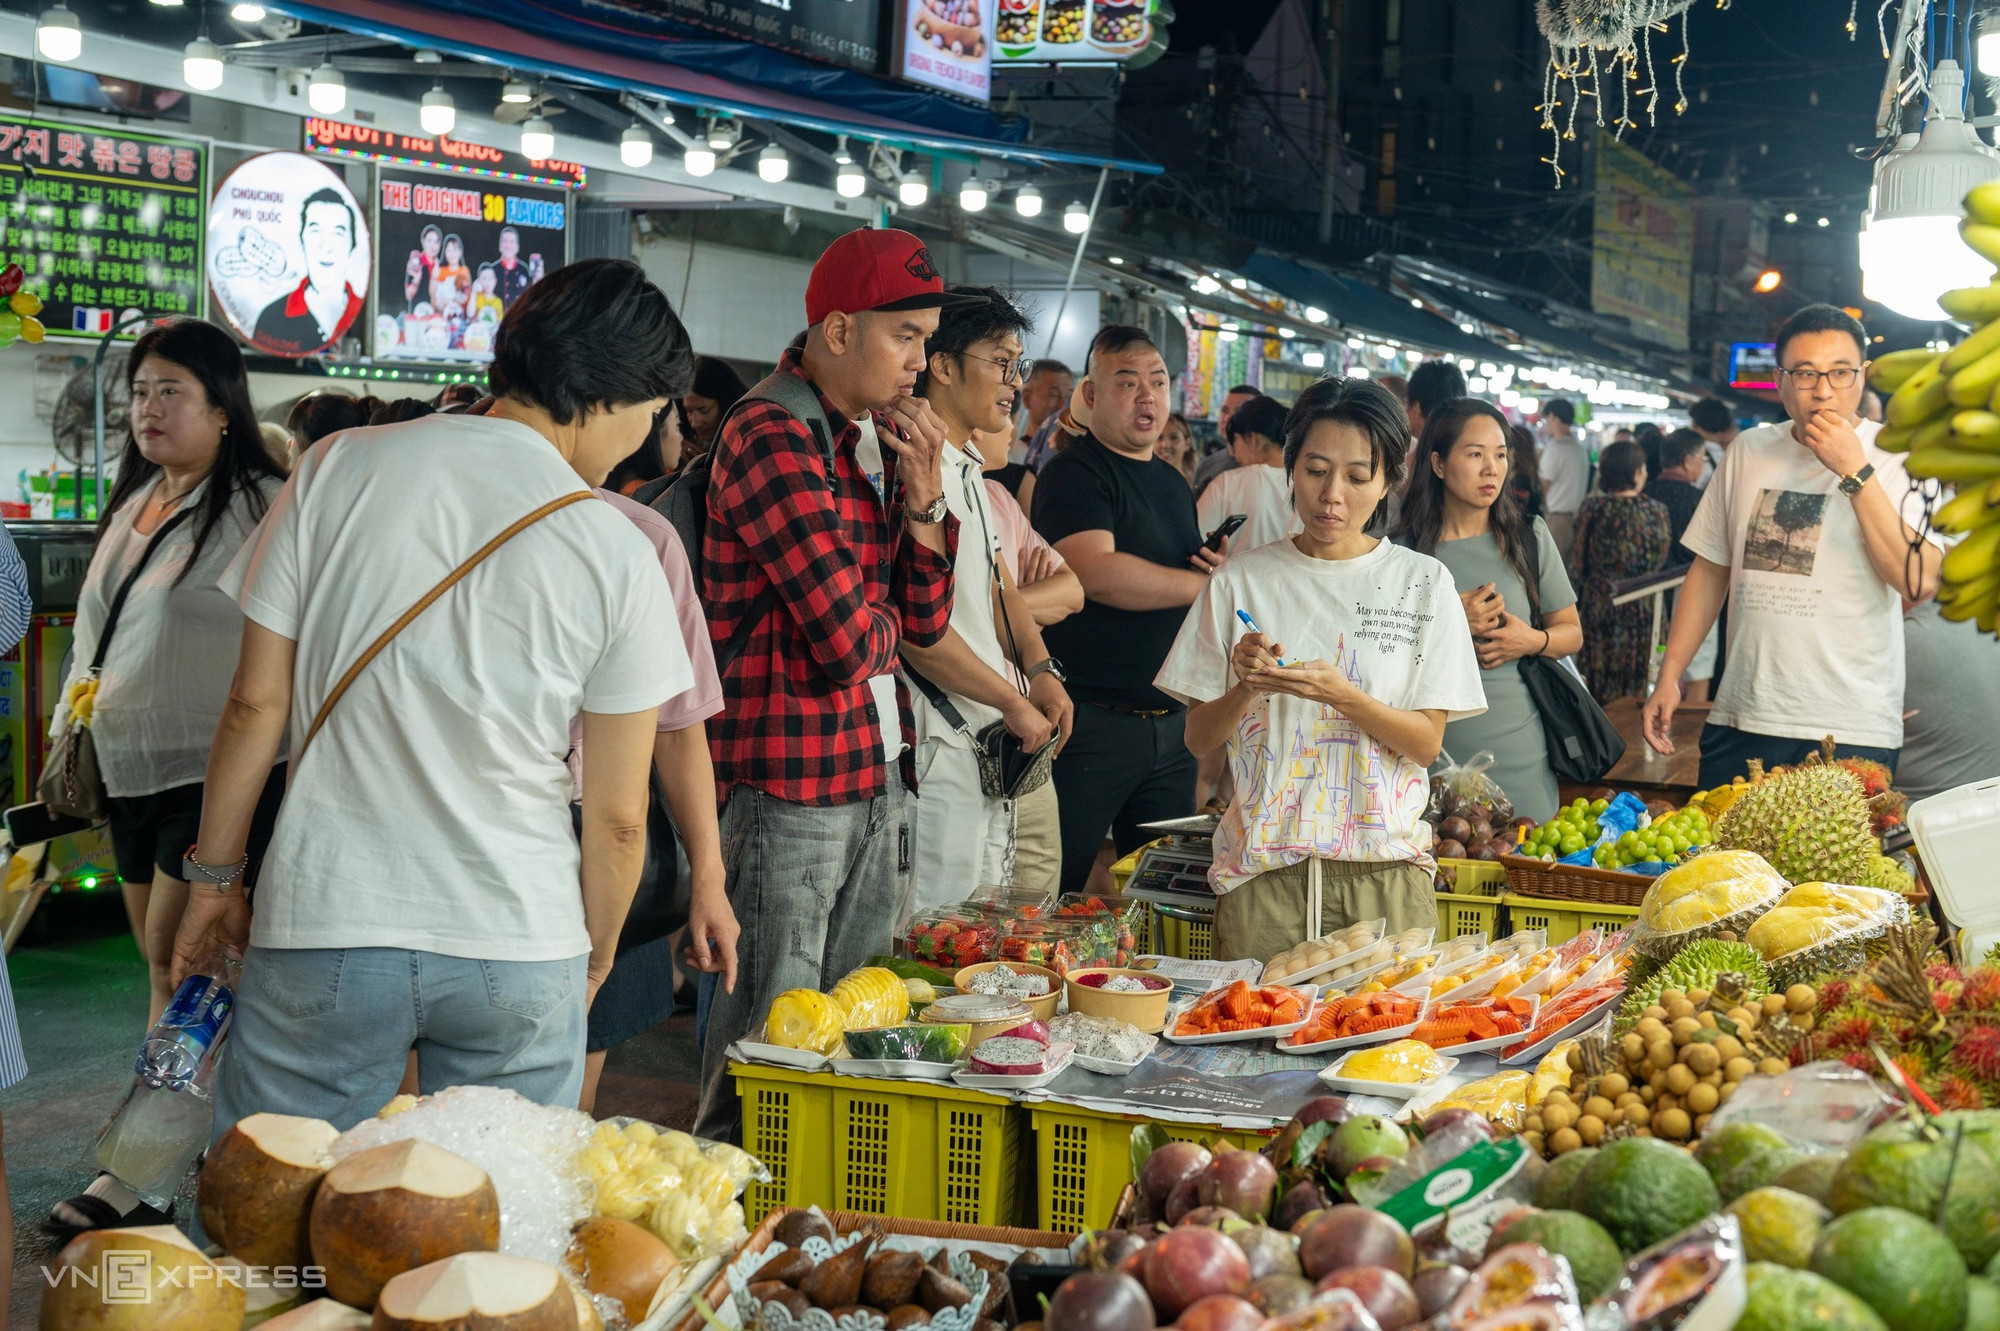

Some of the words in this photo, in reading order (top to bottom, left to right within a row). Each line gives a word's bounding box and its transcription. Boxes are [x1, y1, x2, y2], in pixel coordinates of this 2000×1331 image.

[0, 125, 50, 165] 가지
[58, 133, 86, 169] 맛
[90, 136, 142, 175] 볶은
[147, 145, 197, 182] 땅콩
[77, 185, 103, 206] 그의
[106, 188, 143, 211] 가족과
[231, 187, 285, 204] CHOUCHOU
[381, 180, 412, 212] THE
[413, 184, 483, 221] ORIGINAL
[483, 193, 505, 223] 30
[505, 197, 566, 230] FLAVORS
[68, 208, 119, 231] 땅으로
[53, 281, 68, 302] 수
[71, 283, 98, 304] 없는
[1355, 606, 1373, 617] May
[1374, 608, 1388, 617] you
[1389, 607, 1417, 621] become
[1416, 612, 1434, 624] your
[1361, 619, 1378, 627] own
[1354, 628, 1380, 640] relying
[1381, 632, 1392, 640] on
[1378, 641, 1395, 654] light
